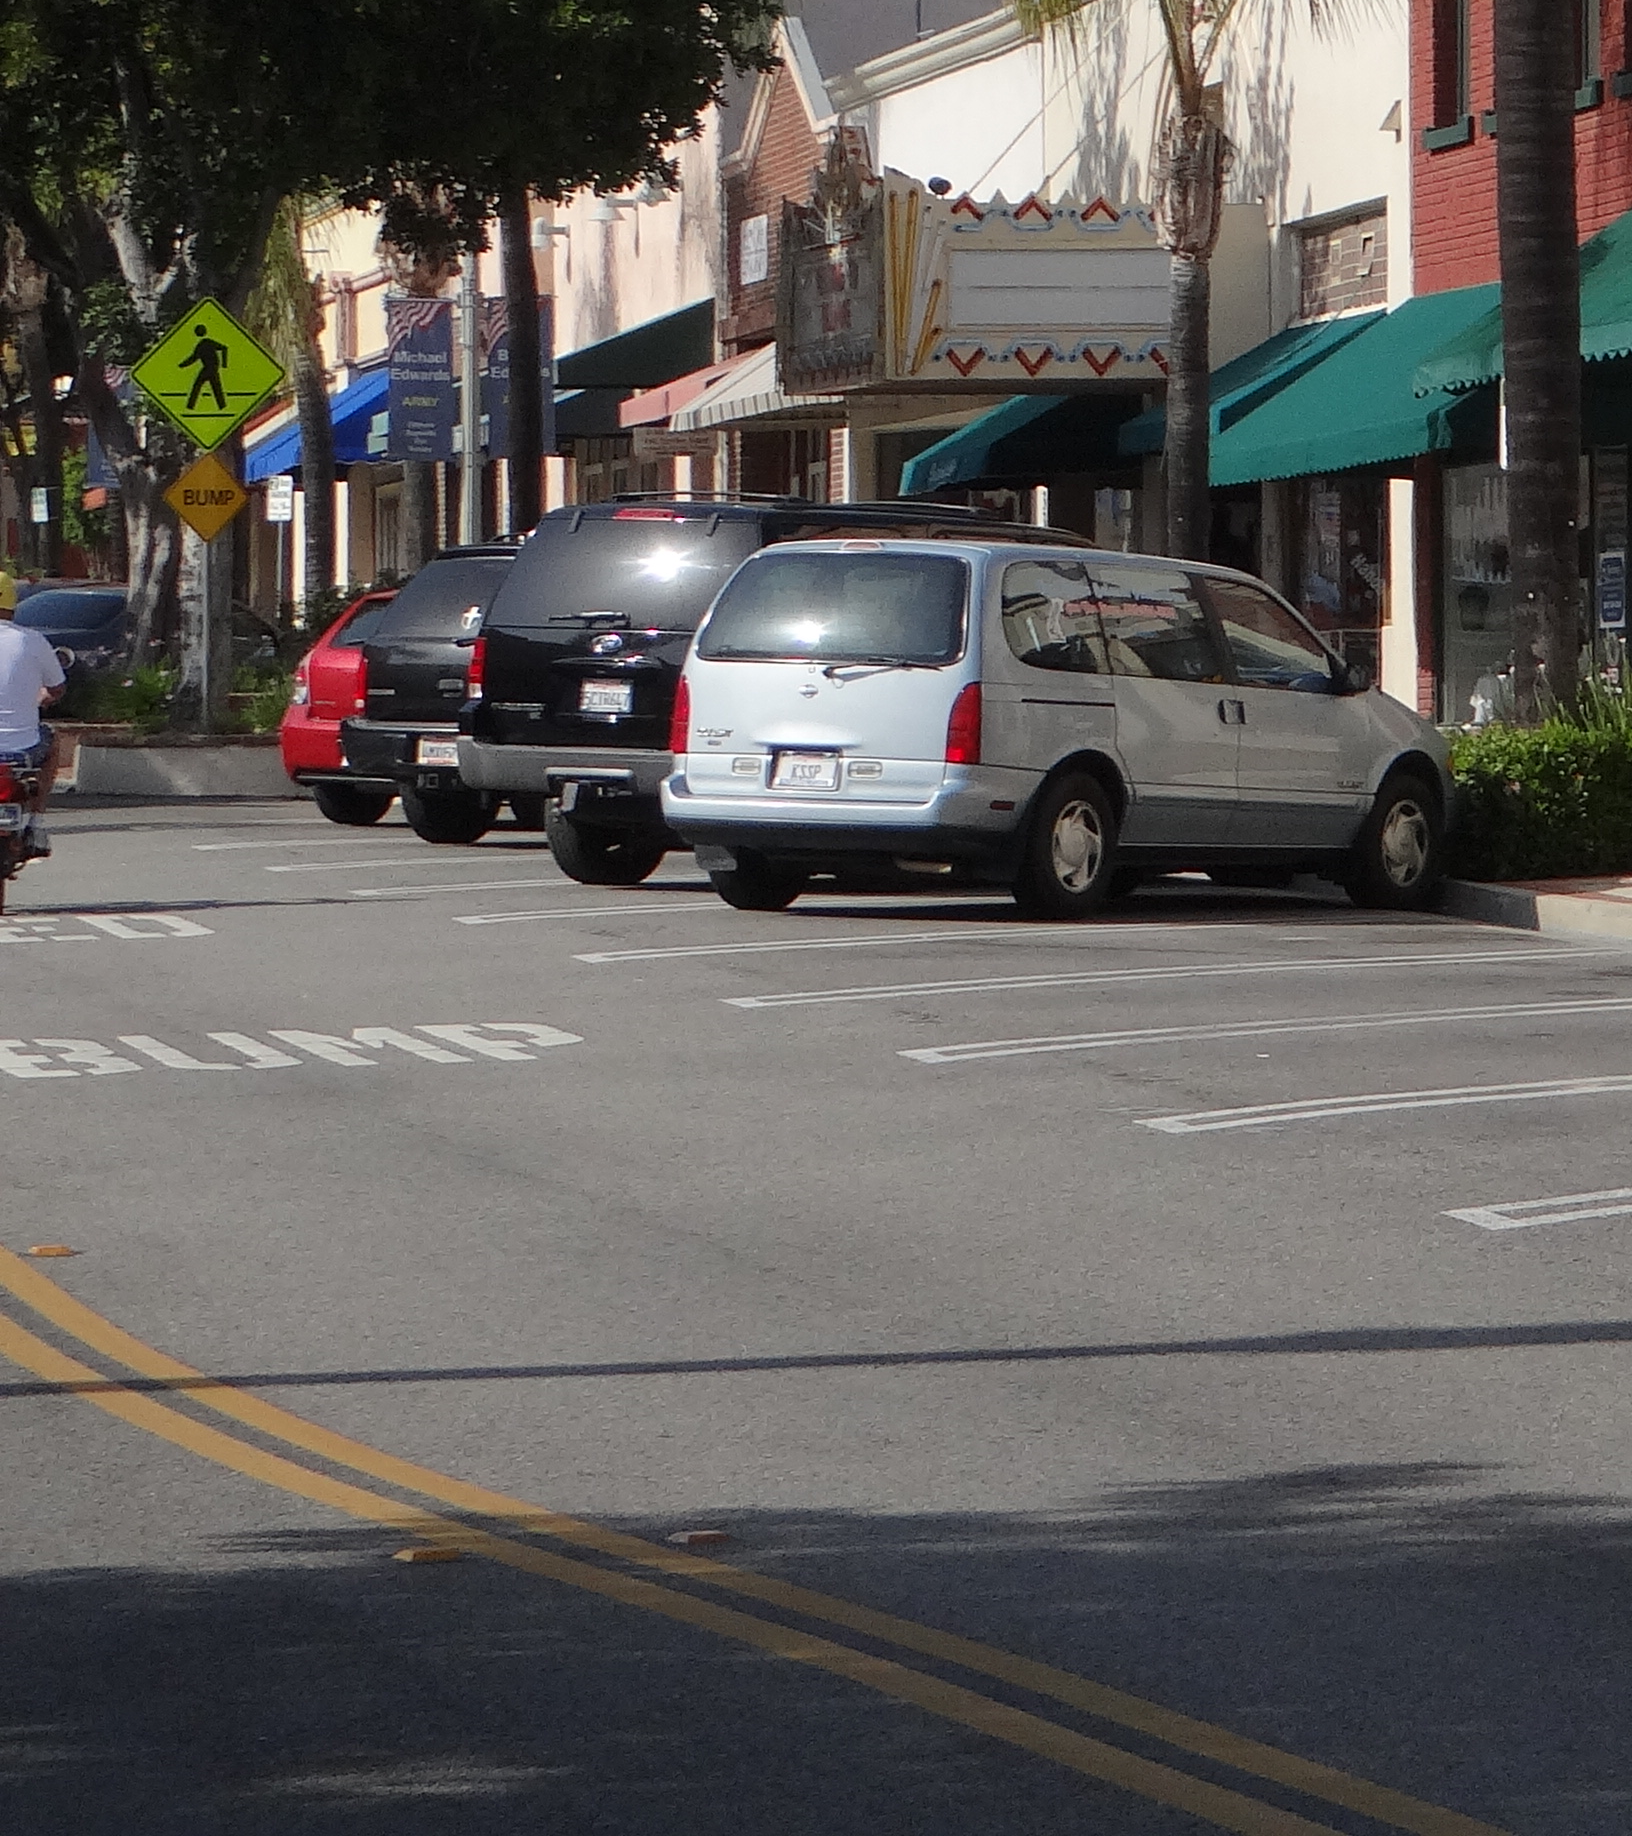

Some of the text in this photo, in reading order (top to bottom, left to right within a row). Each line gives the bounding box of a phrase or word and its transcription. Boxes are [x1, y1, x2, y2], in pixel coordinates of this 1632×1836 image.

[393, 350, 447, 364] Michael
[390, 368, 450, 381] Edwards
[183, 489, 235, 505] BUMP
[0, 1021, 586, 1078] BUMP
